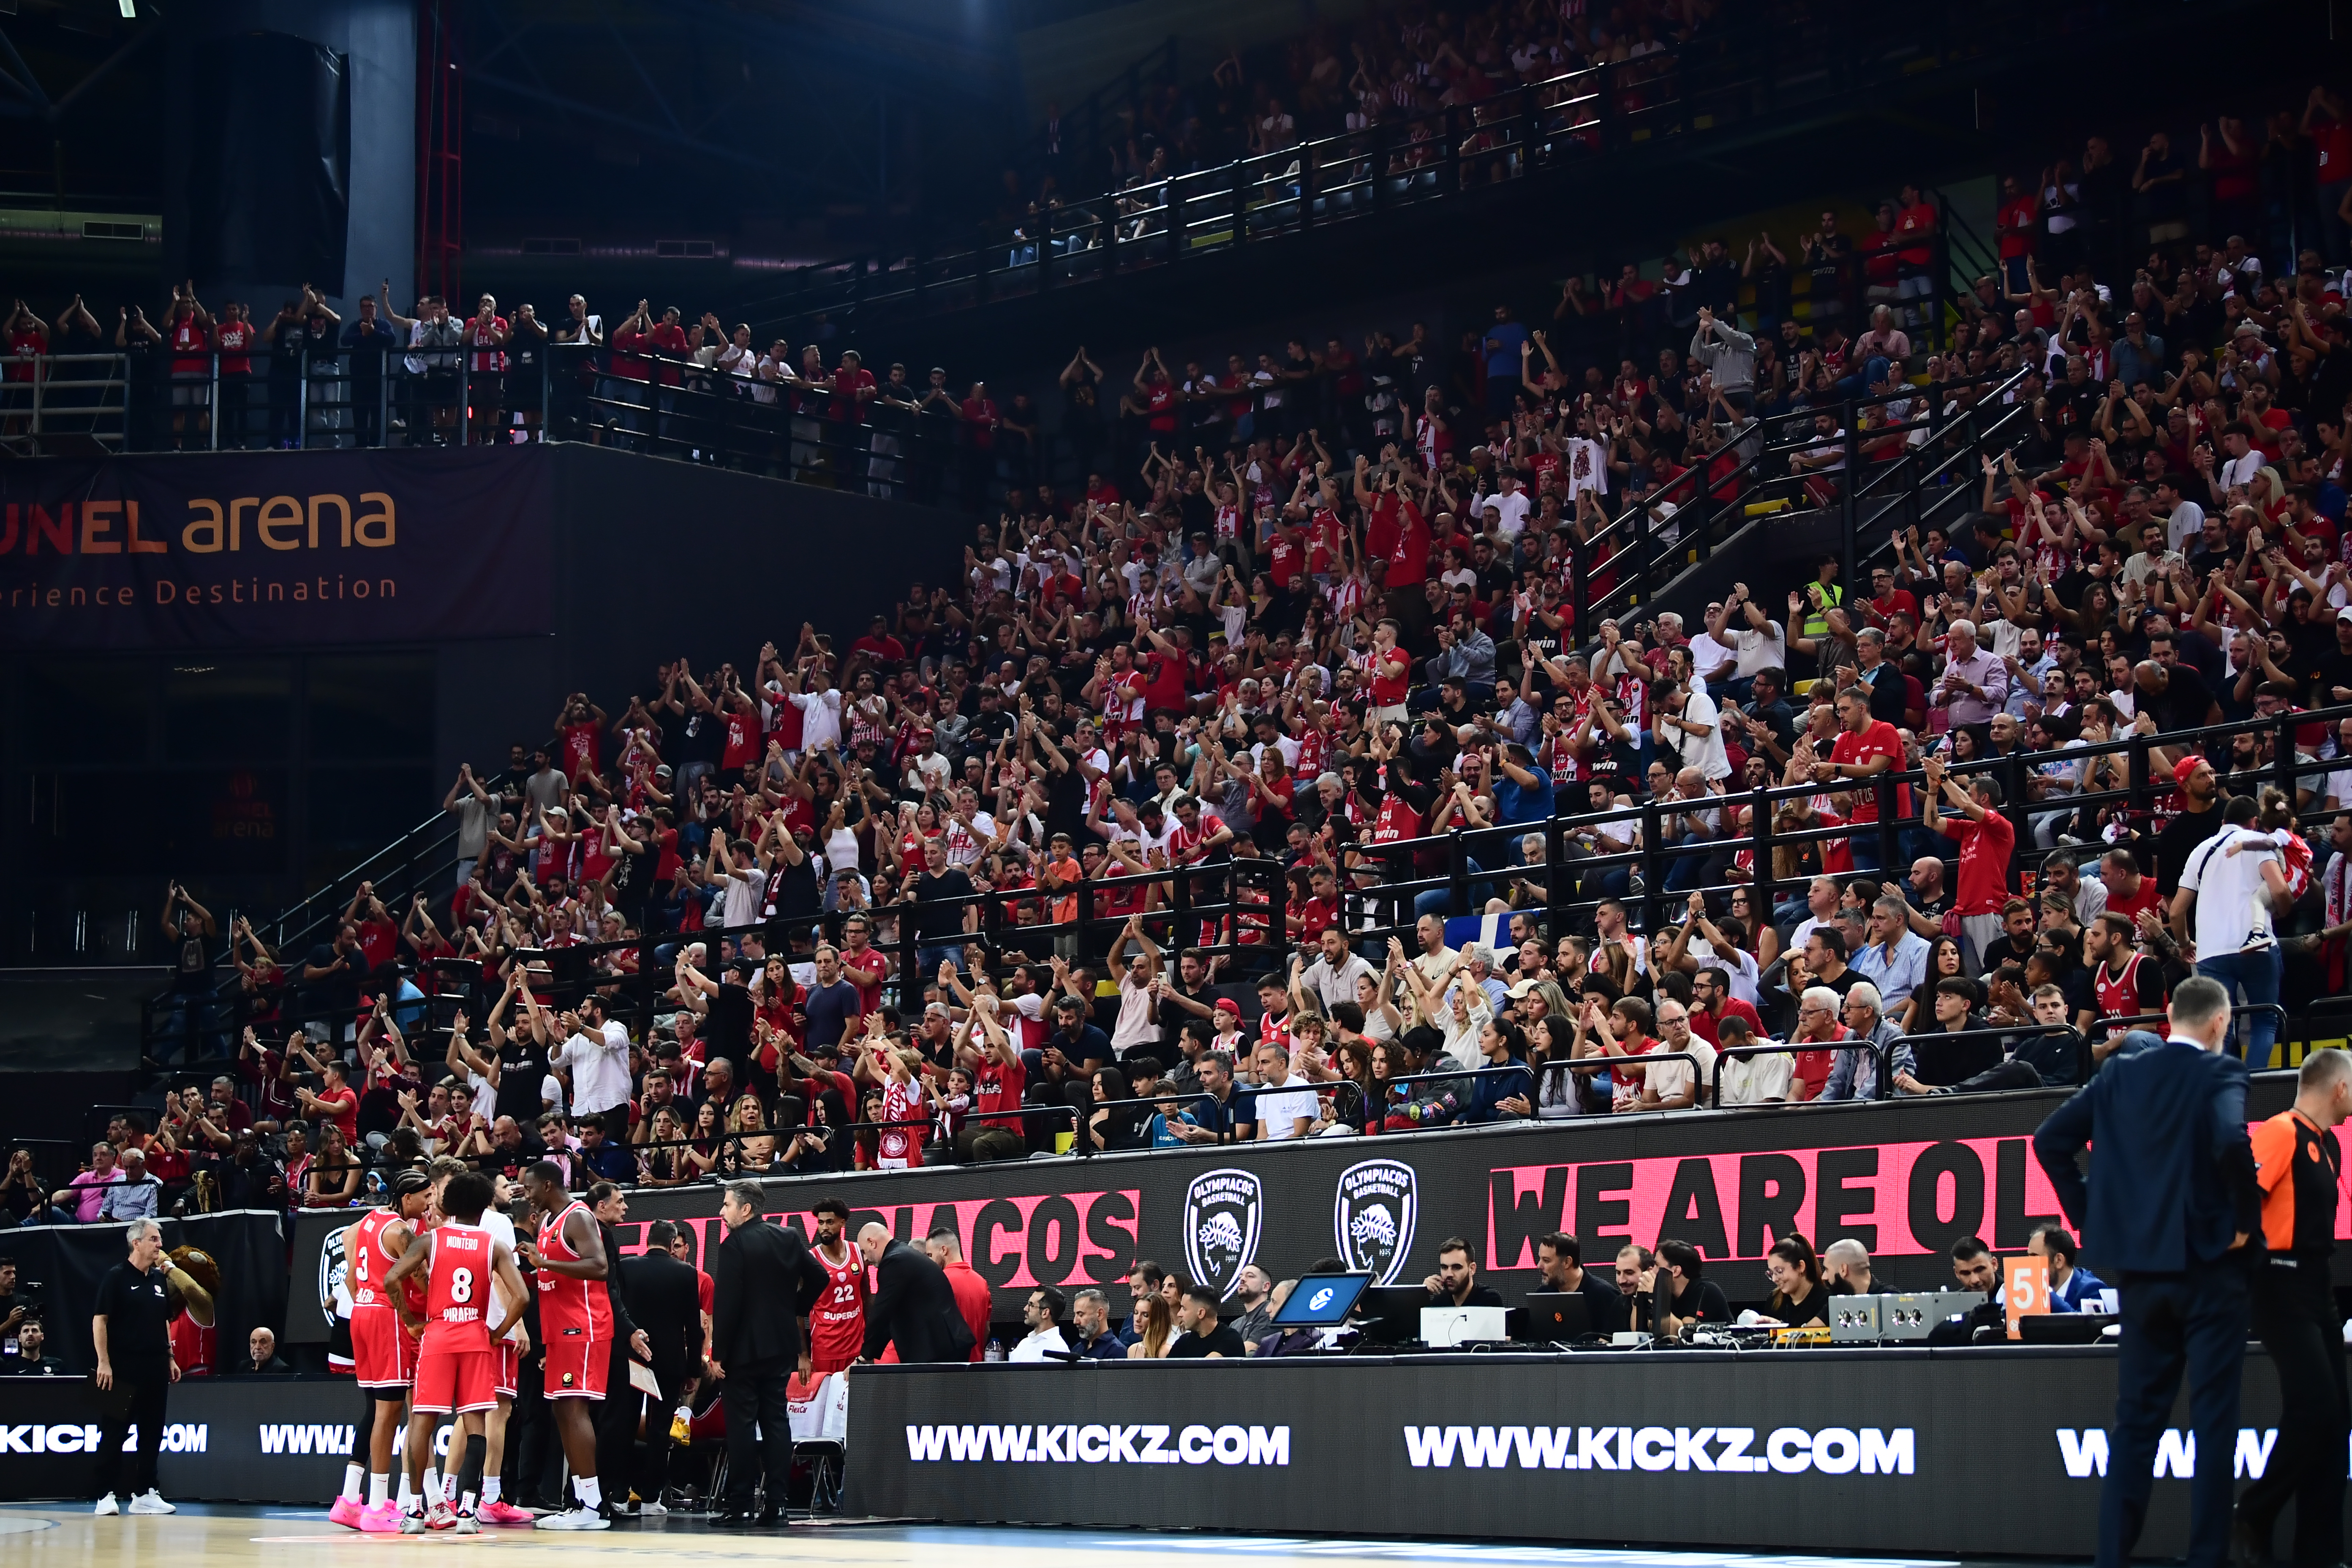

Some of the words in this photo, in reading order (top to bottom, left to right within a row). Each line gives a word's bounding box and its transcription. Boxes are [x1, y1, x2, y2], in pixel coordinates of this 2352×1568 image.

[1417, 444, 1433, 455] win
[182, 492, 396, 553] arena
[0, 582, 134, 607] rience
[156, 573, 396, 605] Destination
[1298, 760, 1317, 772] win
[1375, 825, 1399, 839] win
[1194, 1177, 1255, 1199] OLYMPIACOS
[1345, 1168, 1409, 1191] OLYMPIACOS
[1201, 1192, 1245, 1208] BASKETBALL
[1353, 1183, 1399, 1200] BASKETBALL
[1489, 1162, 1634, 1269] WE
[1655, 1147, 1880, 1260] ARE
[1908, 1141, 2063, 1252] OL
[446, 1235, 478, 1250] MONTERO
[356, 1246, 369, 1282] 3
[451, 1267, 474, 1303] 8
[834, 1284, 854, 1304] 22
[2013, 1268, 2035, 1310] 5
[443, 1307, 479, 1323] PIRAEUS
[823, 1305, 861, 1321] SUPERBET
[789, 1405, 808, 1414] FlexCar
[906, 1424, 1290, 1465] WWW.KICKZ.COM
[1403, 1426, 1914, 1474] WWW.KICKZ.COM
